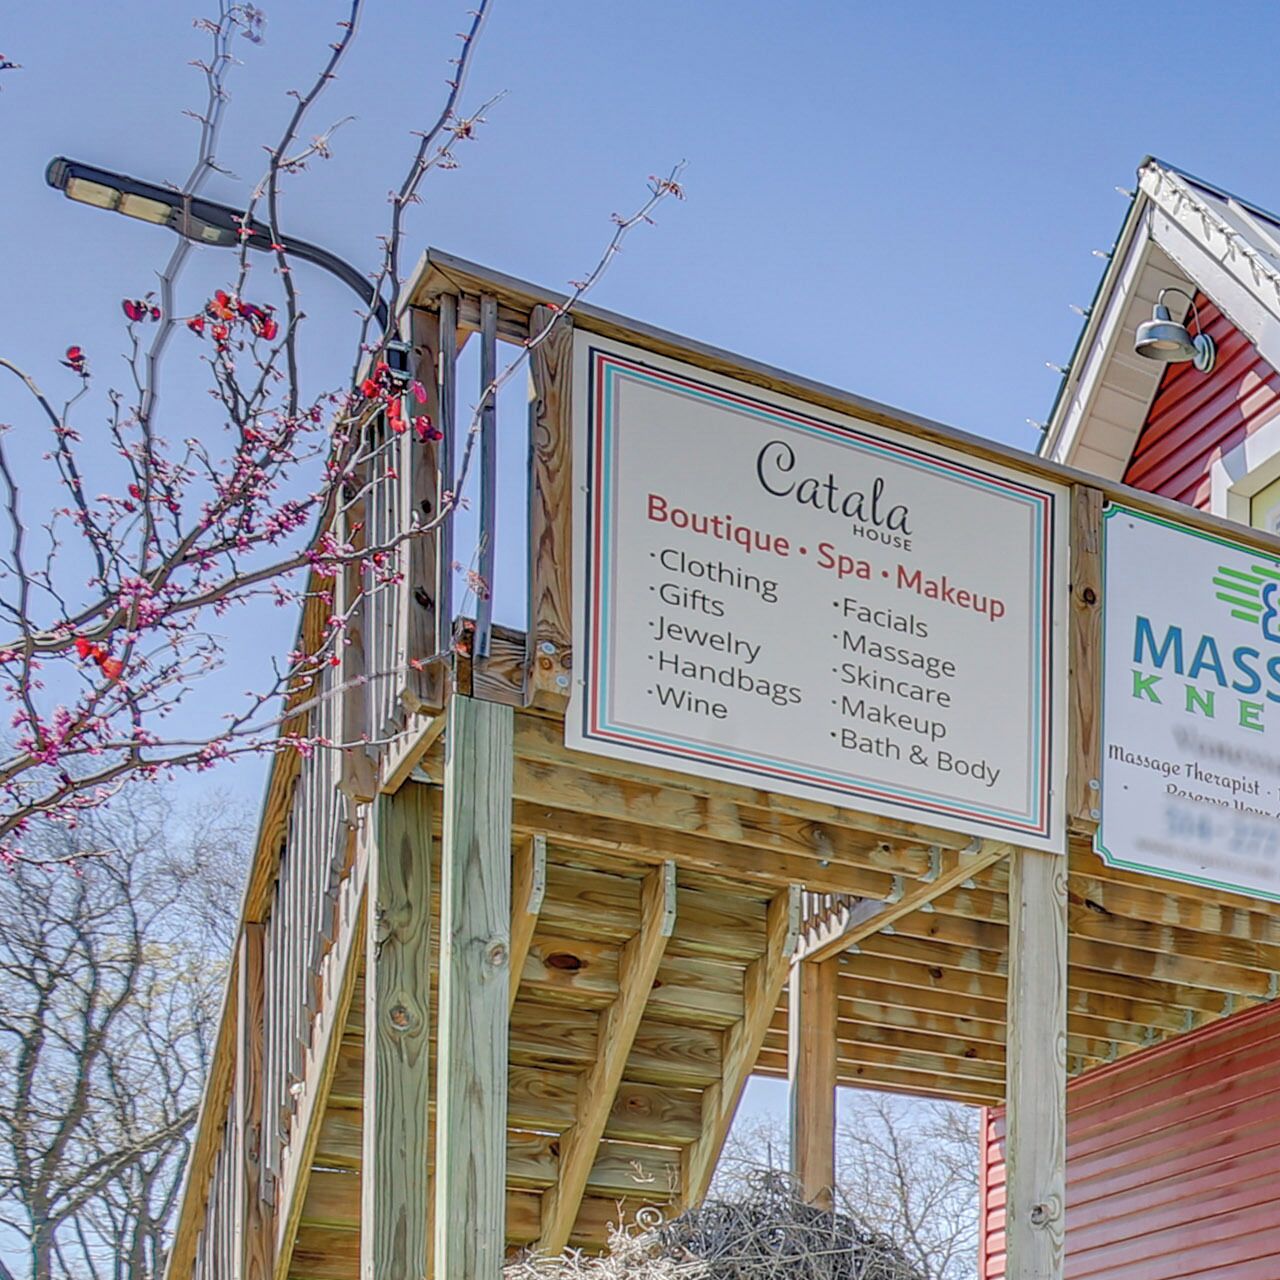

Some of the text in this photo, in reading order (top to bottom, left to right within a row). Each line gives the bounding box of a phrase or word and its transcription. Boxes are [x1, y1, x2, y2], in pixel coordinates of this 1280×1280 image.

[757, 440, 912, 535] Catala
[647, 494, 1006, 621] Boutique Spa Makeup
[853, 524, 912, 552] HOUSE
[659, 581, 725, 618] Gifts
[660, 548, 779, 603] Clothing
[653, 616, 762, 664] Jewelry
[843, 597, 929, 639] Facials
[659, 650, 802, 705] Handbags
[843, 630, 956, 678] Massage
[656, 683, 729, 720] Wine
[841, 662, 952, 709] Skincare
[841, 695, 948, 741] Makeup
[841, 727, 1001, 788] Bath & Body
[1109, 743, 1181, 777] Massage
[1185, 761, 1260, 798] Therapist
